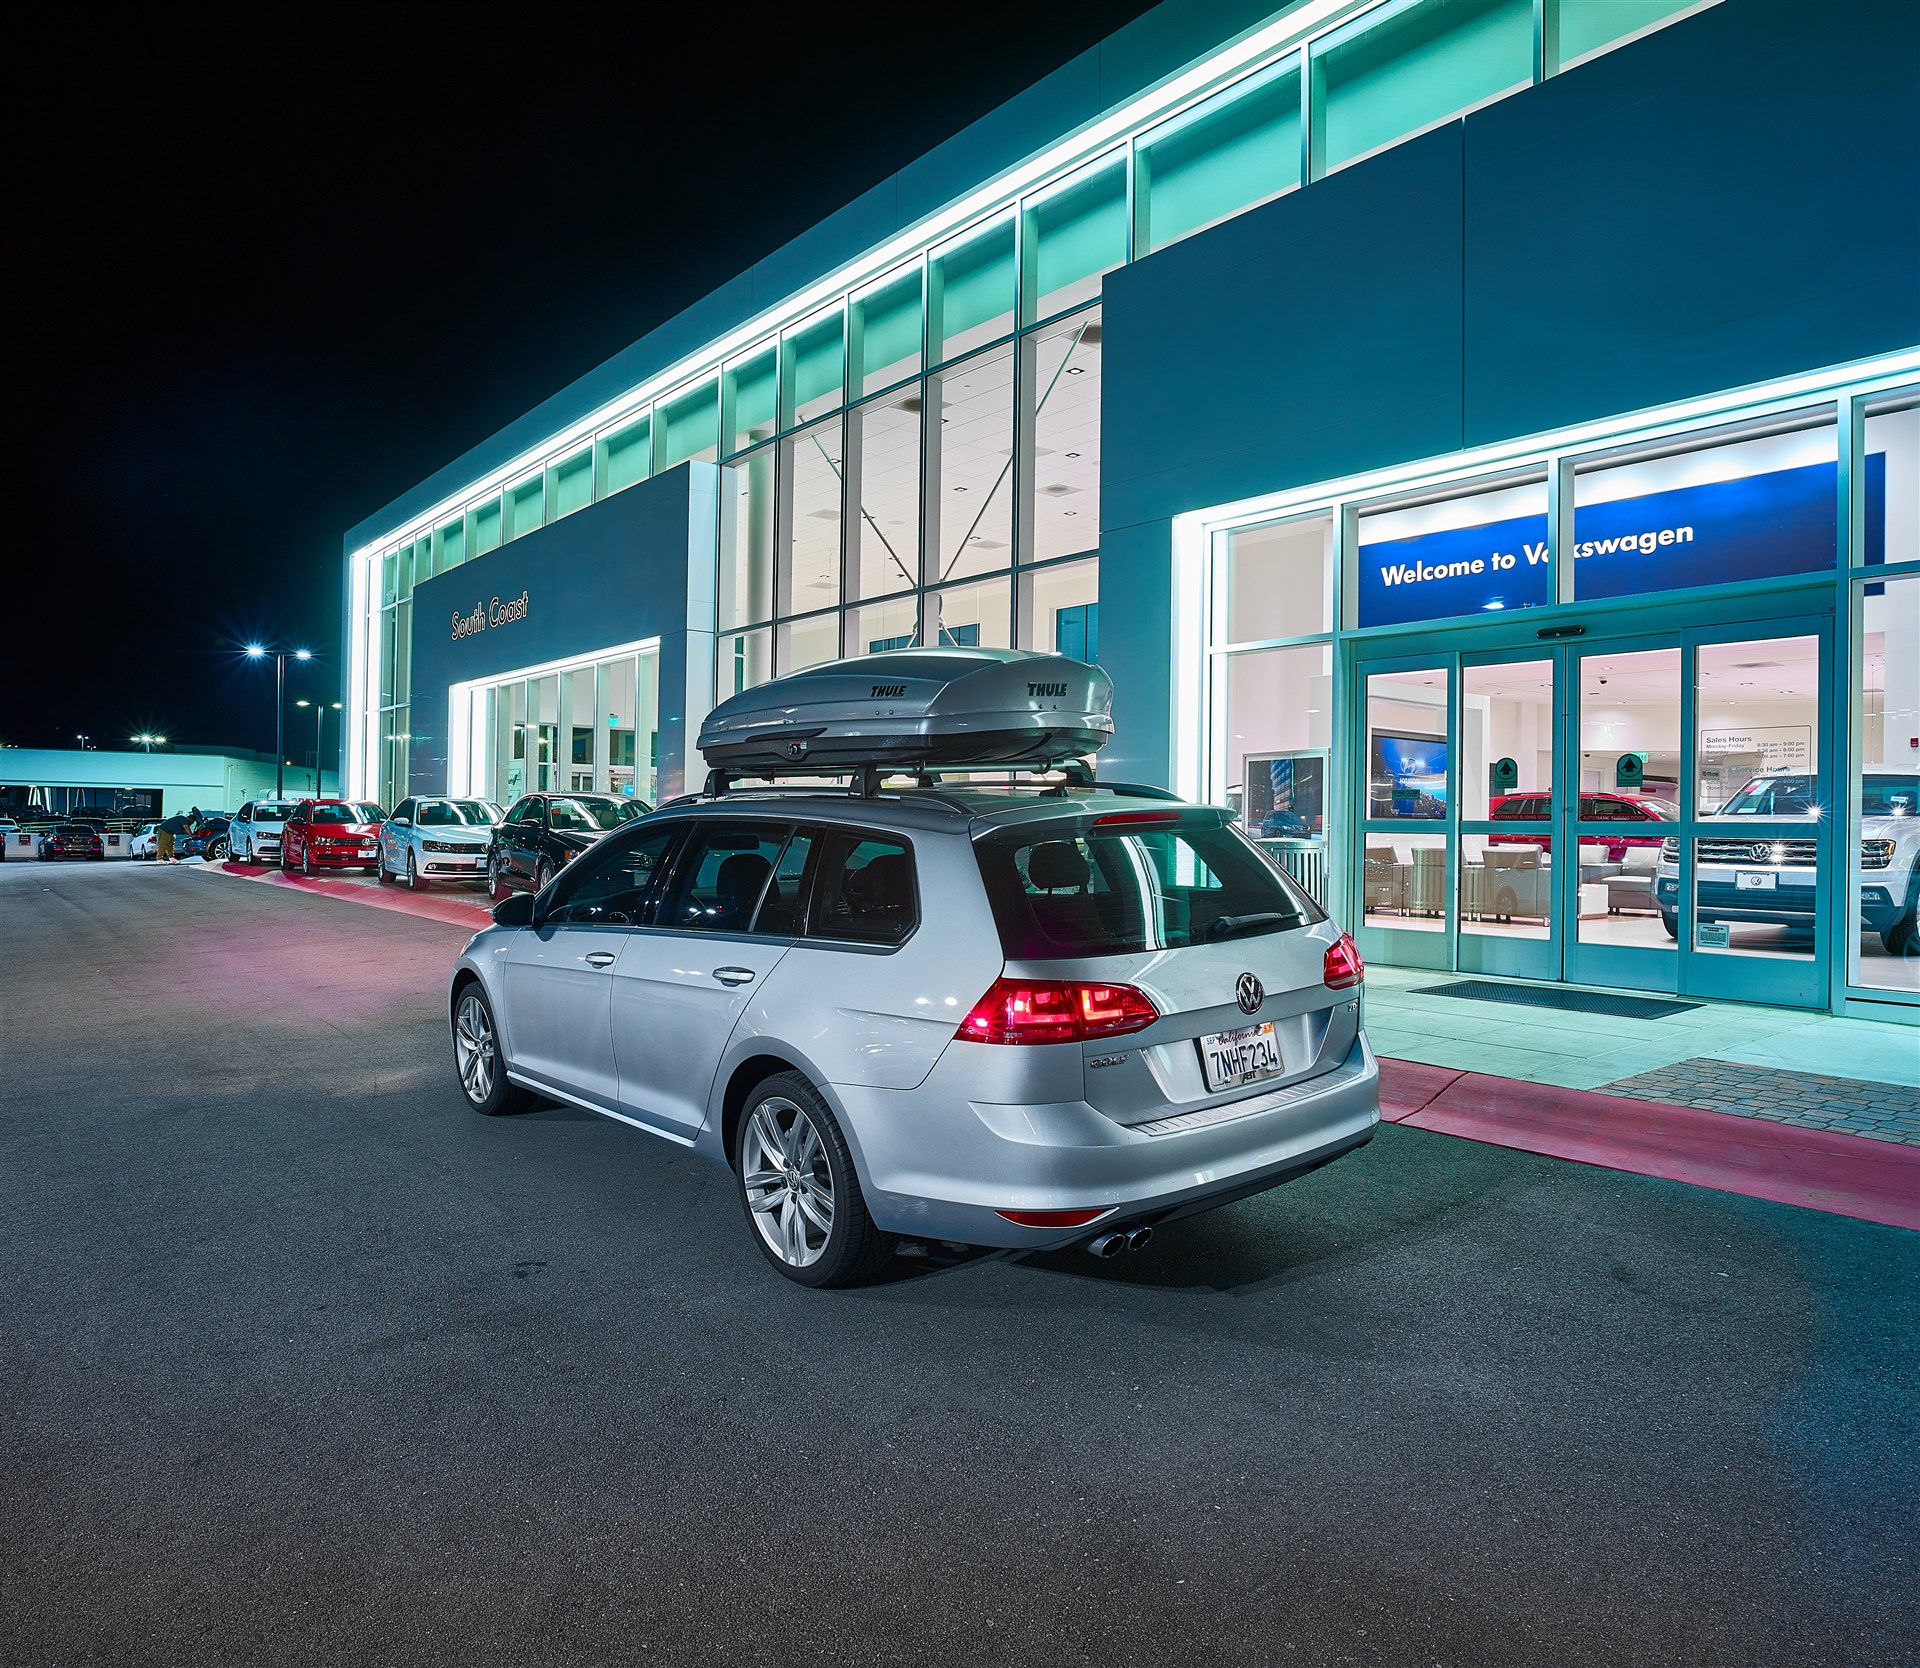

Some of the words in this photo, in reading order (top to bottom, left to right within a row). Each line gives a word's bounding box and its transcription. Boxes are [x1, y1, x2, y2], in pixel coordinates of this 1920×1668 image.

[1381, 557, 1485, 587] Welcome
[1491, 552, 1516, 570] to
[1523, 526, 1694, 566] Vkswagen
[451, 601, 486, 640] South
[489, 590, 528, 627] Coast
[871, 685, 907, 698] THULE
[1028, 683, 1068, 697] THULE
[1206, 1037, 1216, 1045] SEP
[1091, 1054, 1130, 1068] GOLF
[1210, 1039, 1278, 1079] 7NHF234
[1241, 1070, 1257, 1084] ABT
